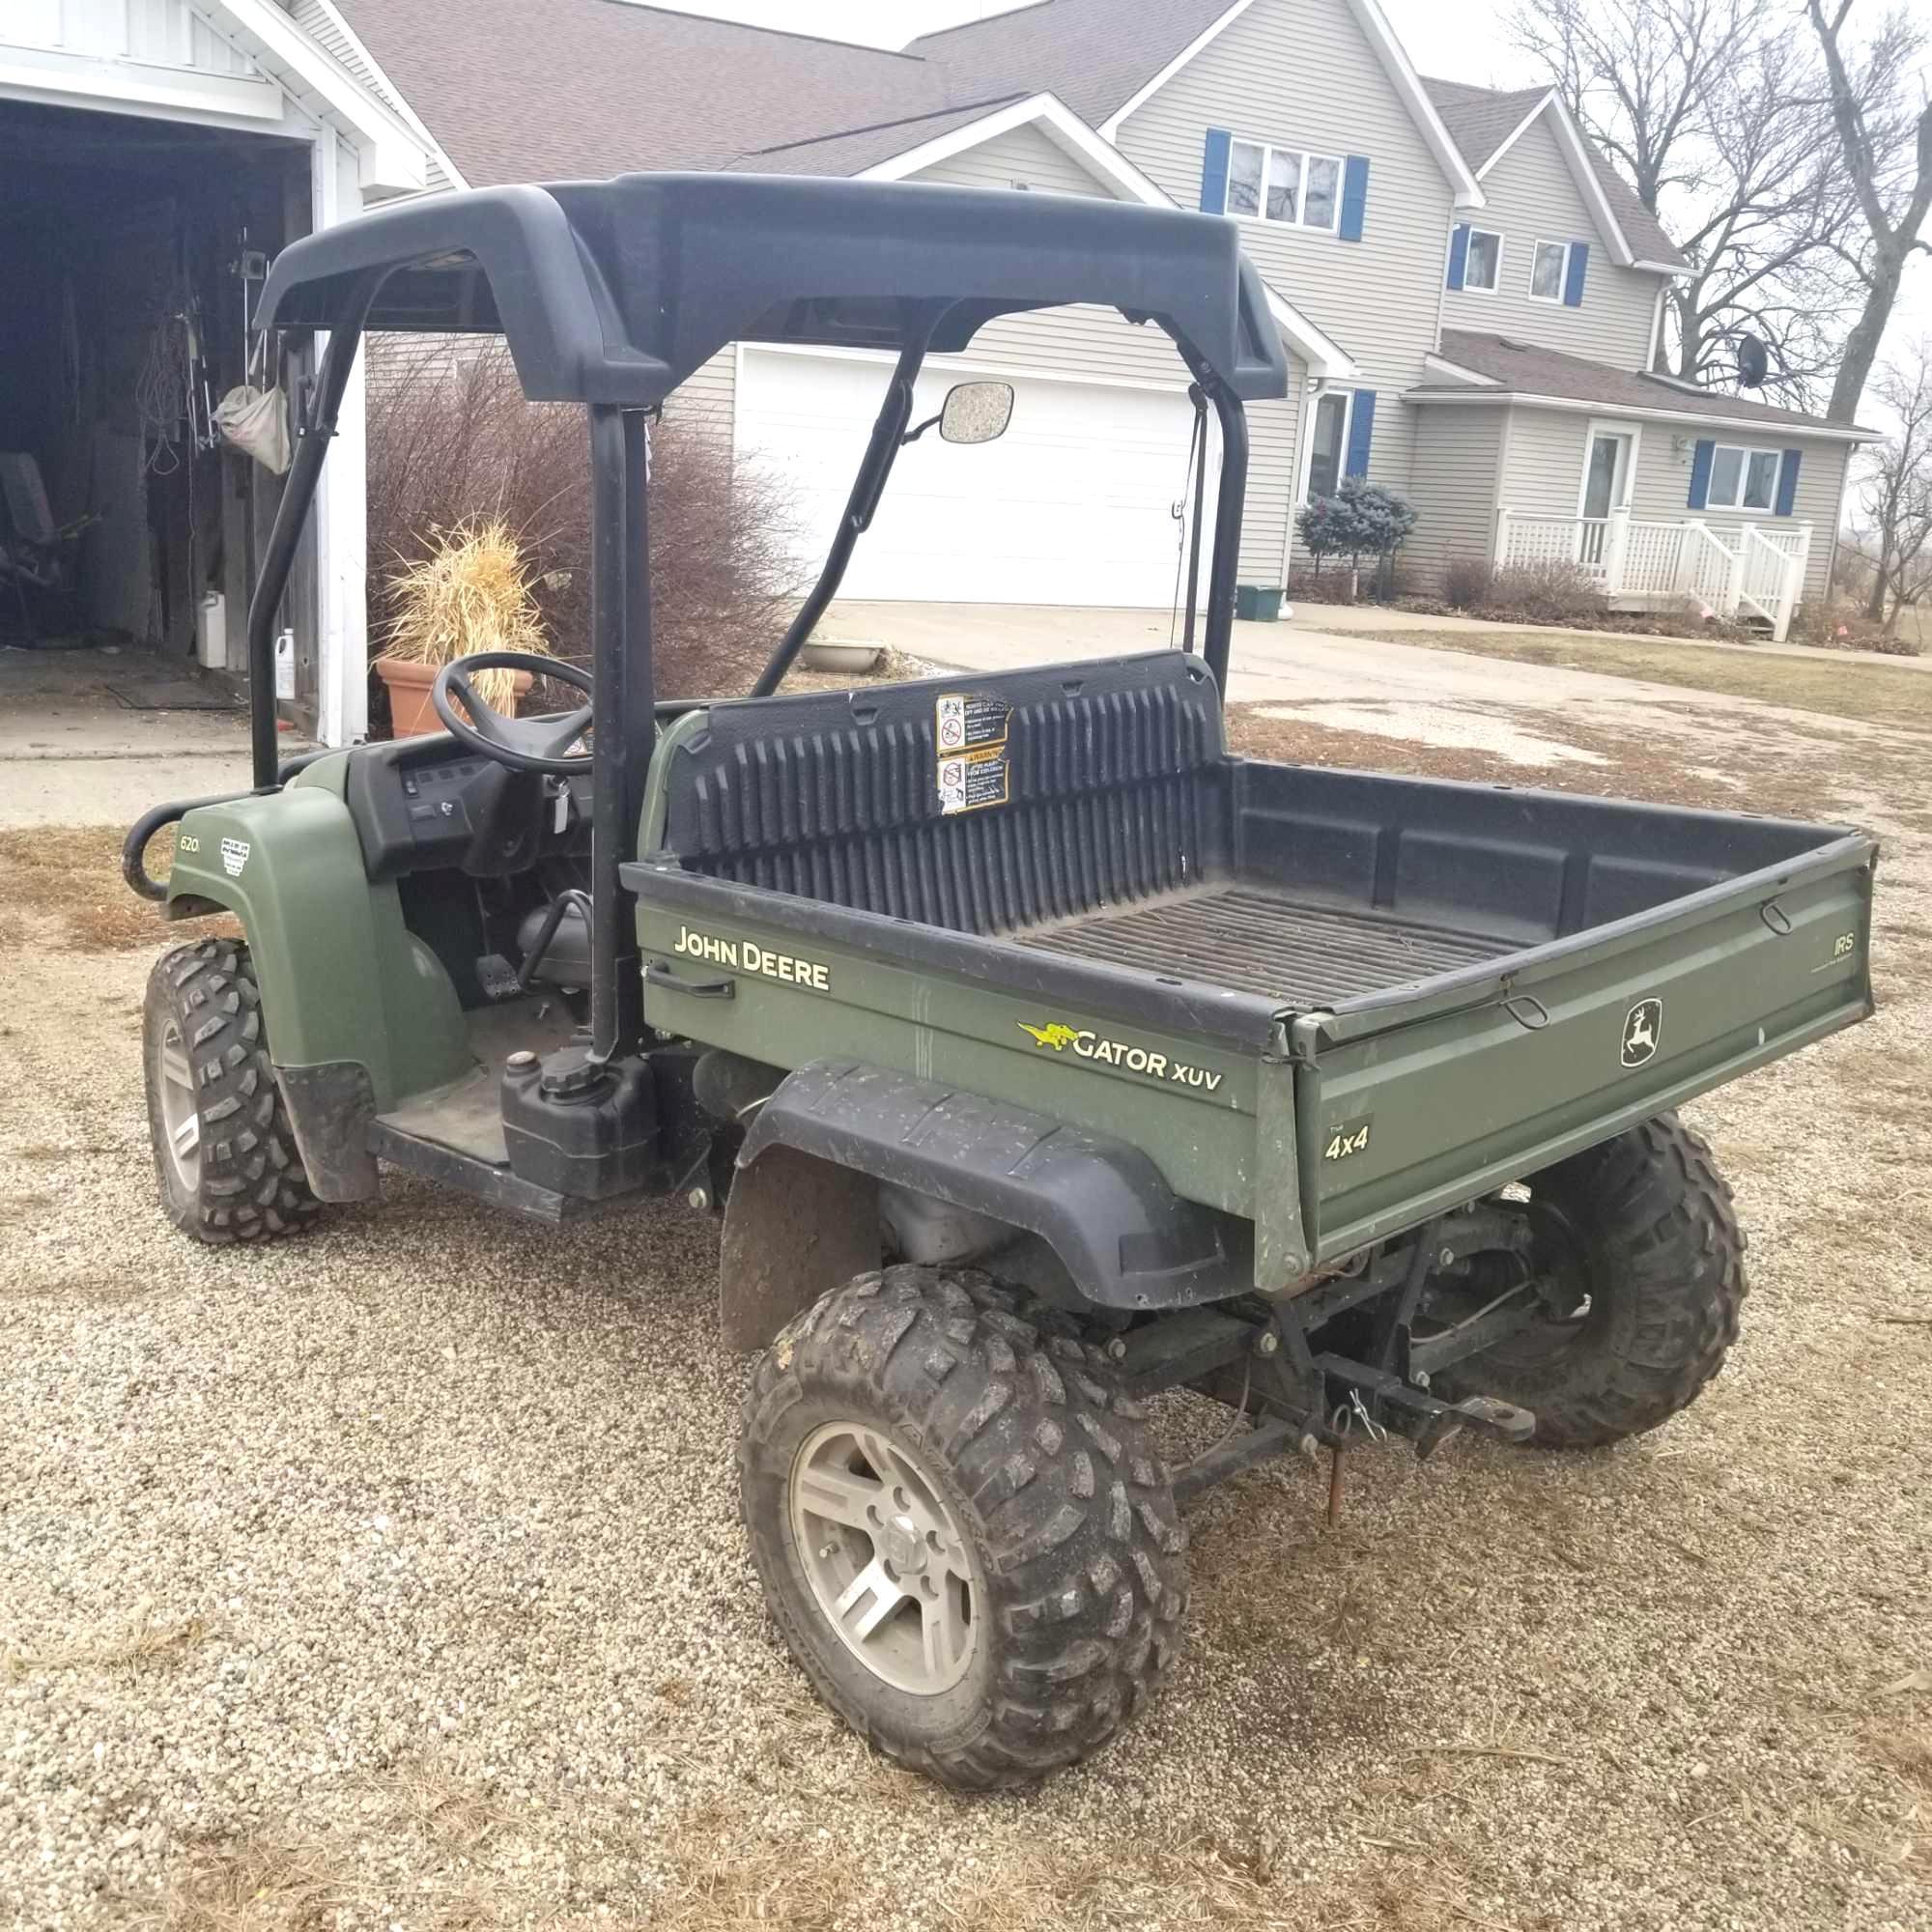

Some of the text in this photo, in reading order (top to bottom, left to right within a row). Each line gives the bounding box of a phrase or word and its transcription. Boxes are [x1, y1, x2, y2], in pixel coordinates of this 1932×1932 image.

[674, 925, 830, 991] JOHN DEERE
[1833, 932, 1855, 956] IRS
[1072, 1030, 1222, 1091] GATOR XUV
[1325, 1125, 1369, 1160] 4x4
